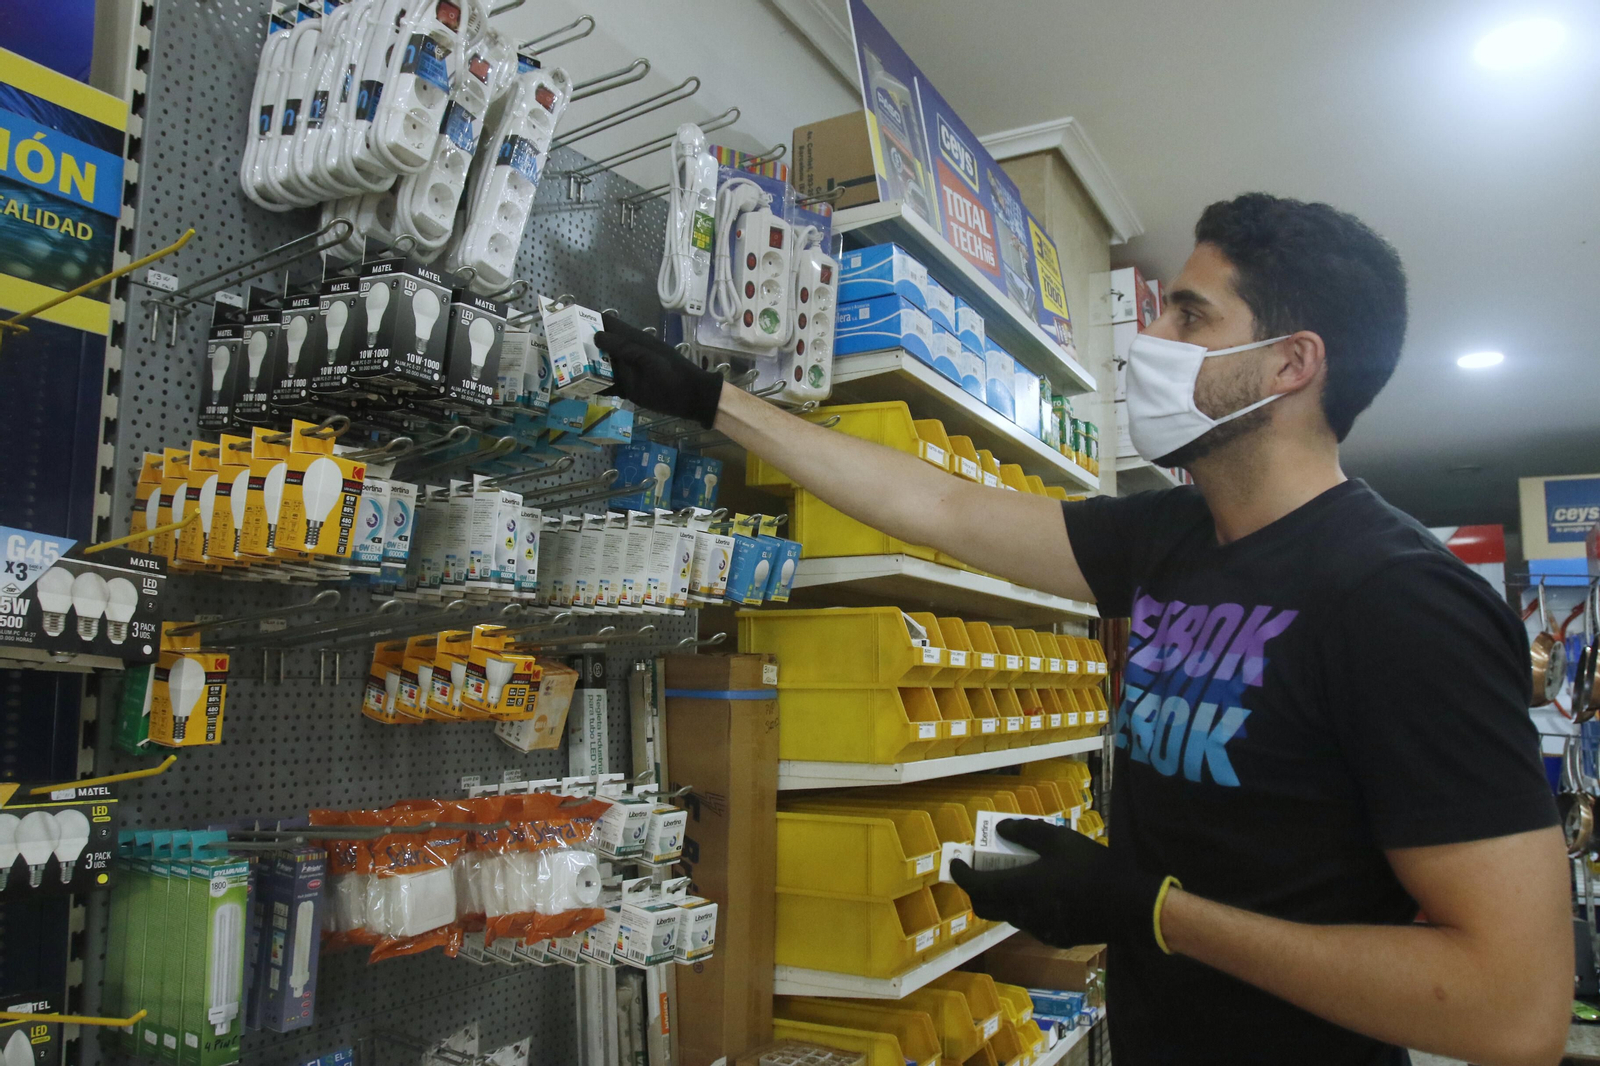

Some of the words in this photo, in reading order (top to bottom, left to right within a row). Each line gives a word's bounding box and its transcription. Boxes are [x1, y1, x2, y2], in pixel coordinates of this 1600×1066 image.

[941, 124, 974, 176] ceys
[943, 184, 991, 239] TOTAL
[950, 221, 984, 261] TECH
[372, 264, 393, 273] MATEL
[418, 268, 442, 283] MATEL
[331, 282, 350, 291] MATEL
[360, 282, 370, 292] LED
[404, 279, 417, 292] LED
[292, 299, 310, 307] MATEL
[475, 297, 497, 312] MATEL
[461, 309, 474, 321] LED
[502, 497, 520, 506] Libertina
[1555, 507, 1600, 523] ceys
[7, 535, 59, 567] G45
[130, 557, 160, 570] MATEL
[143, 578, 157, 589] LED
[132, 622, 139, 638] 3
[140, 622, 156, 632] PACK
[595, 694, 603, 732] Regleta
[78, 787, 110, 796] MATEL
[92, 805, 108, 816] LED
[664, 820, 681, 828] Libertina
[980, 820, 989, 847] Libertina
[85, 853, 93, 869] 3
[94, 852, 111, 861] PACK
[213, 867, 247, 876] SYLVANIA
[211, 881, 226, 890] 1800
[657, 917, 676, 925] Libertina
[695, 913, 712, 922] Libertina
[31, 1025, 48, 1038] LED
